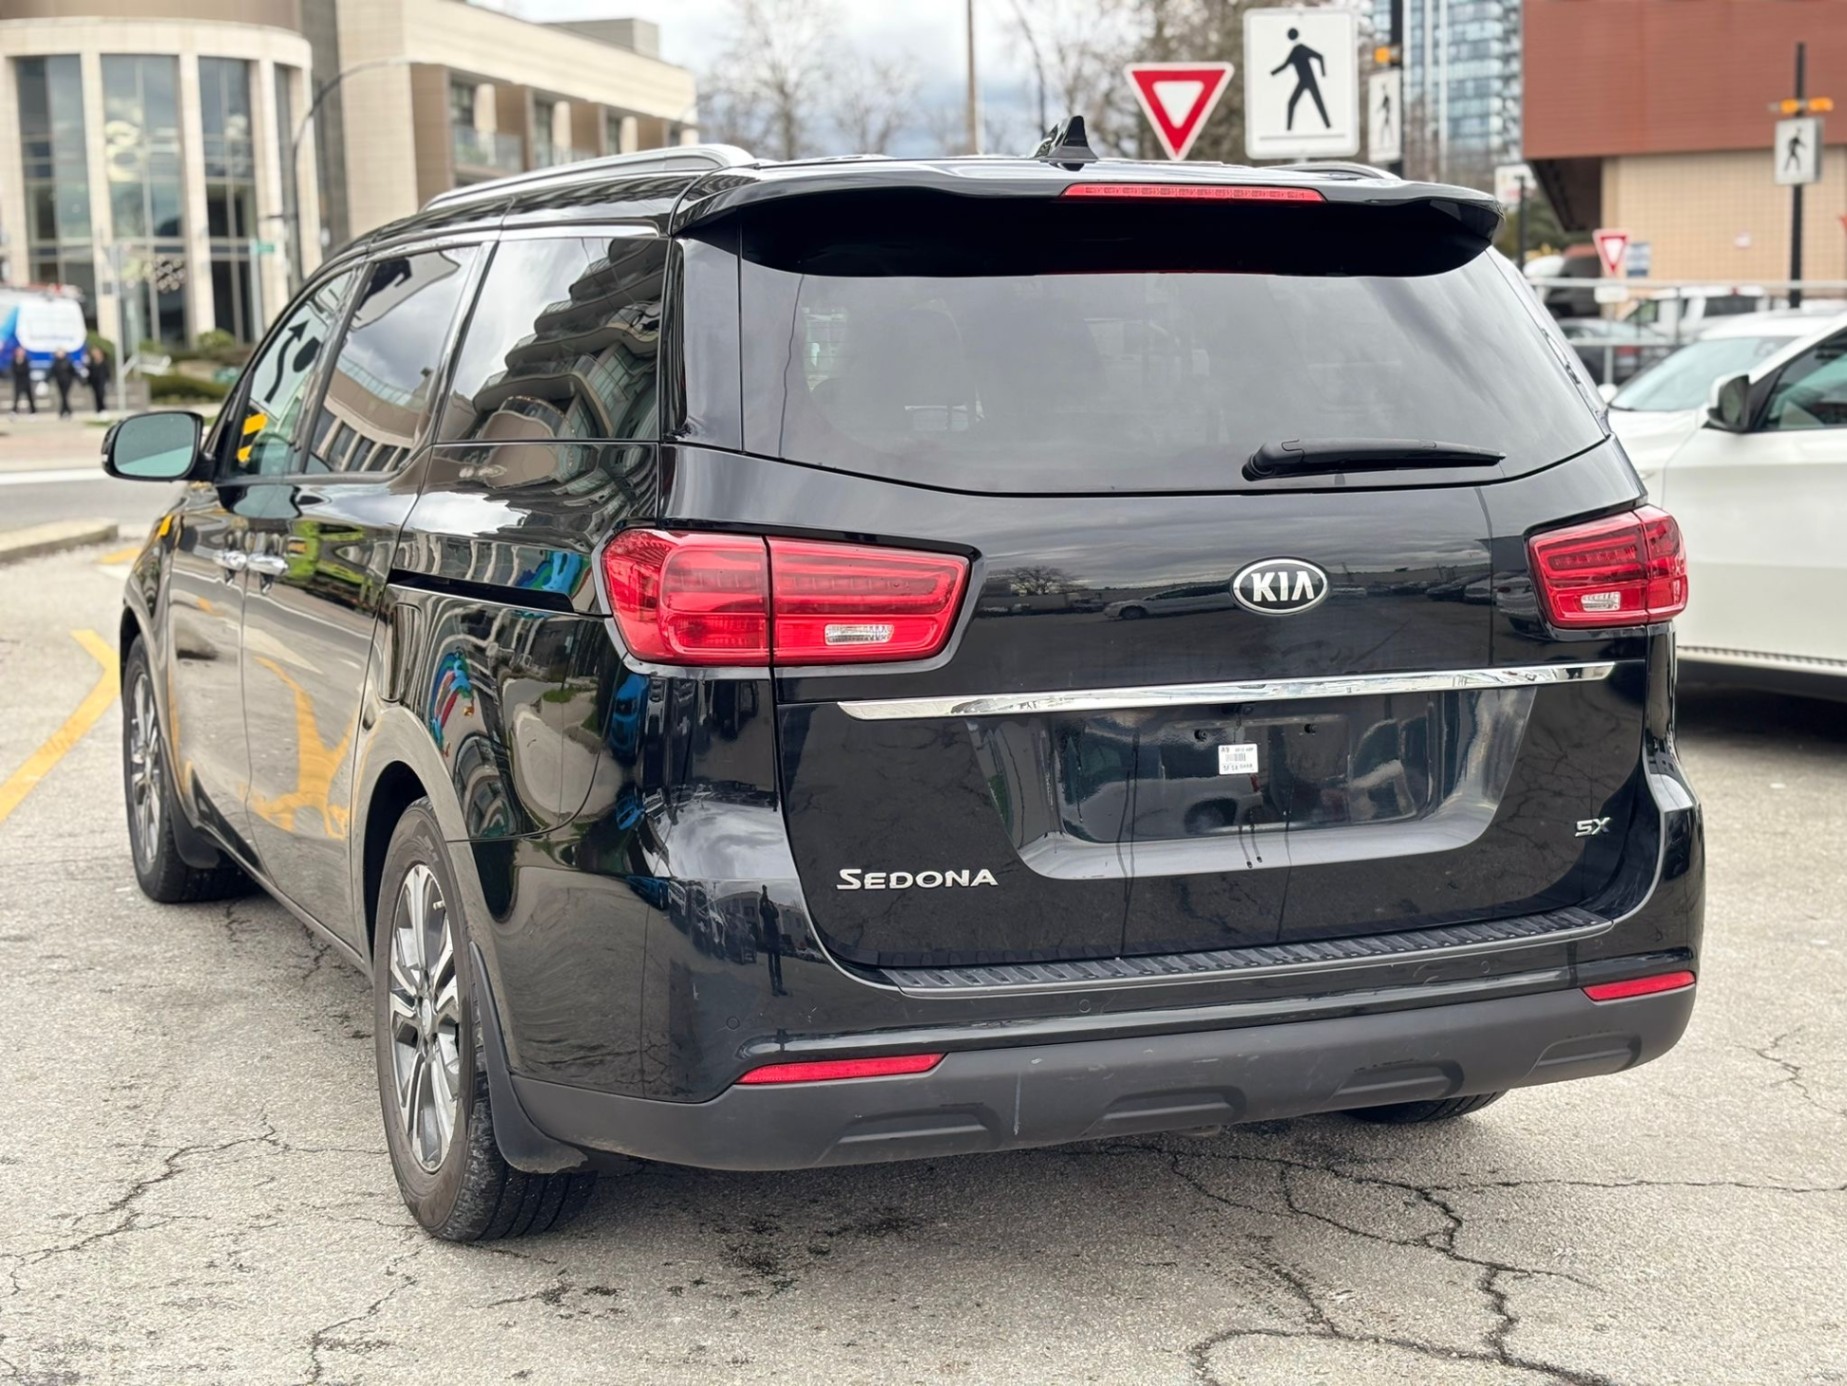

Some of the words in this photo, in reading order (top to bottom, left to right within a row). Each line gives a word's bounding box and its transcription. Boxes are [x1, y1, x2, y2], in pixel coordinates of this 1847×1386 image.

[1250, 570, 1315, 602] KIA
[1574, 816, 1611, 837] SX
[836, 868, 999, 890] SEDONA
